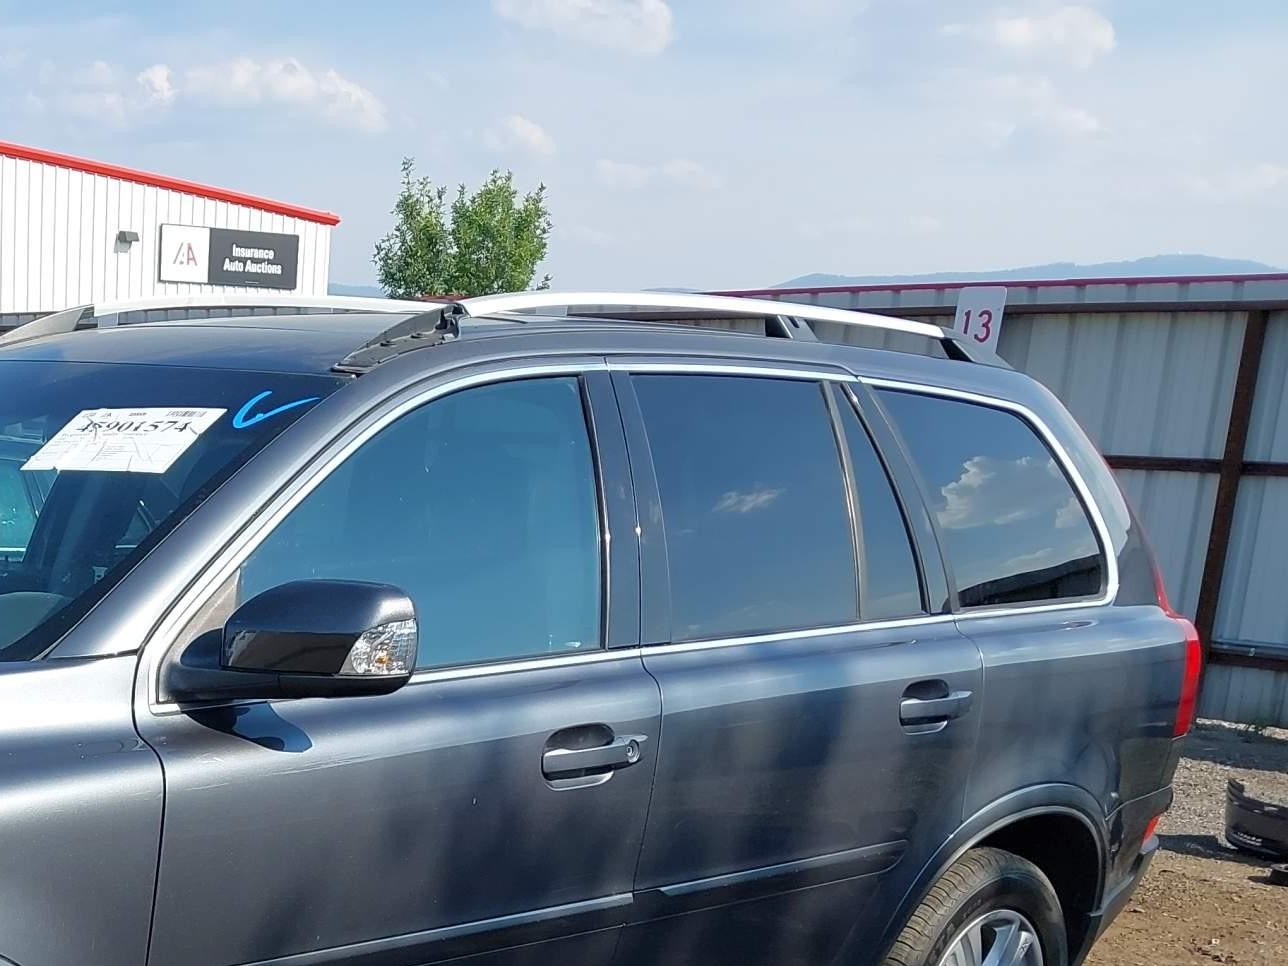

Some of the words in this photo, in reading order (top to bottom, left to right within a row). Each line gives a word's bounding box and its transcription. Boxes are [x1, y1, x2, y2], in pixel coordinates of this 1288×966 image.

[232, 243, 275, 260] Insurance
[223, 257, 244, 272] Auto
[244, 259, 282, 275] Auctions
[963, 309, 993, 343] 13
